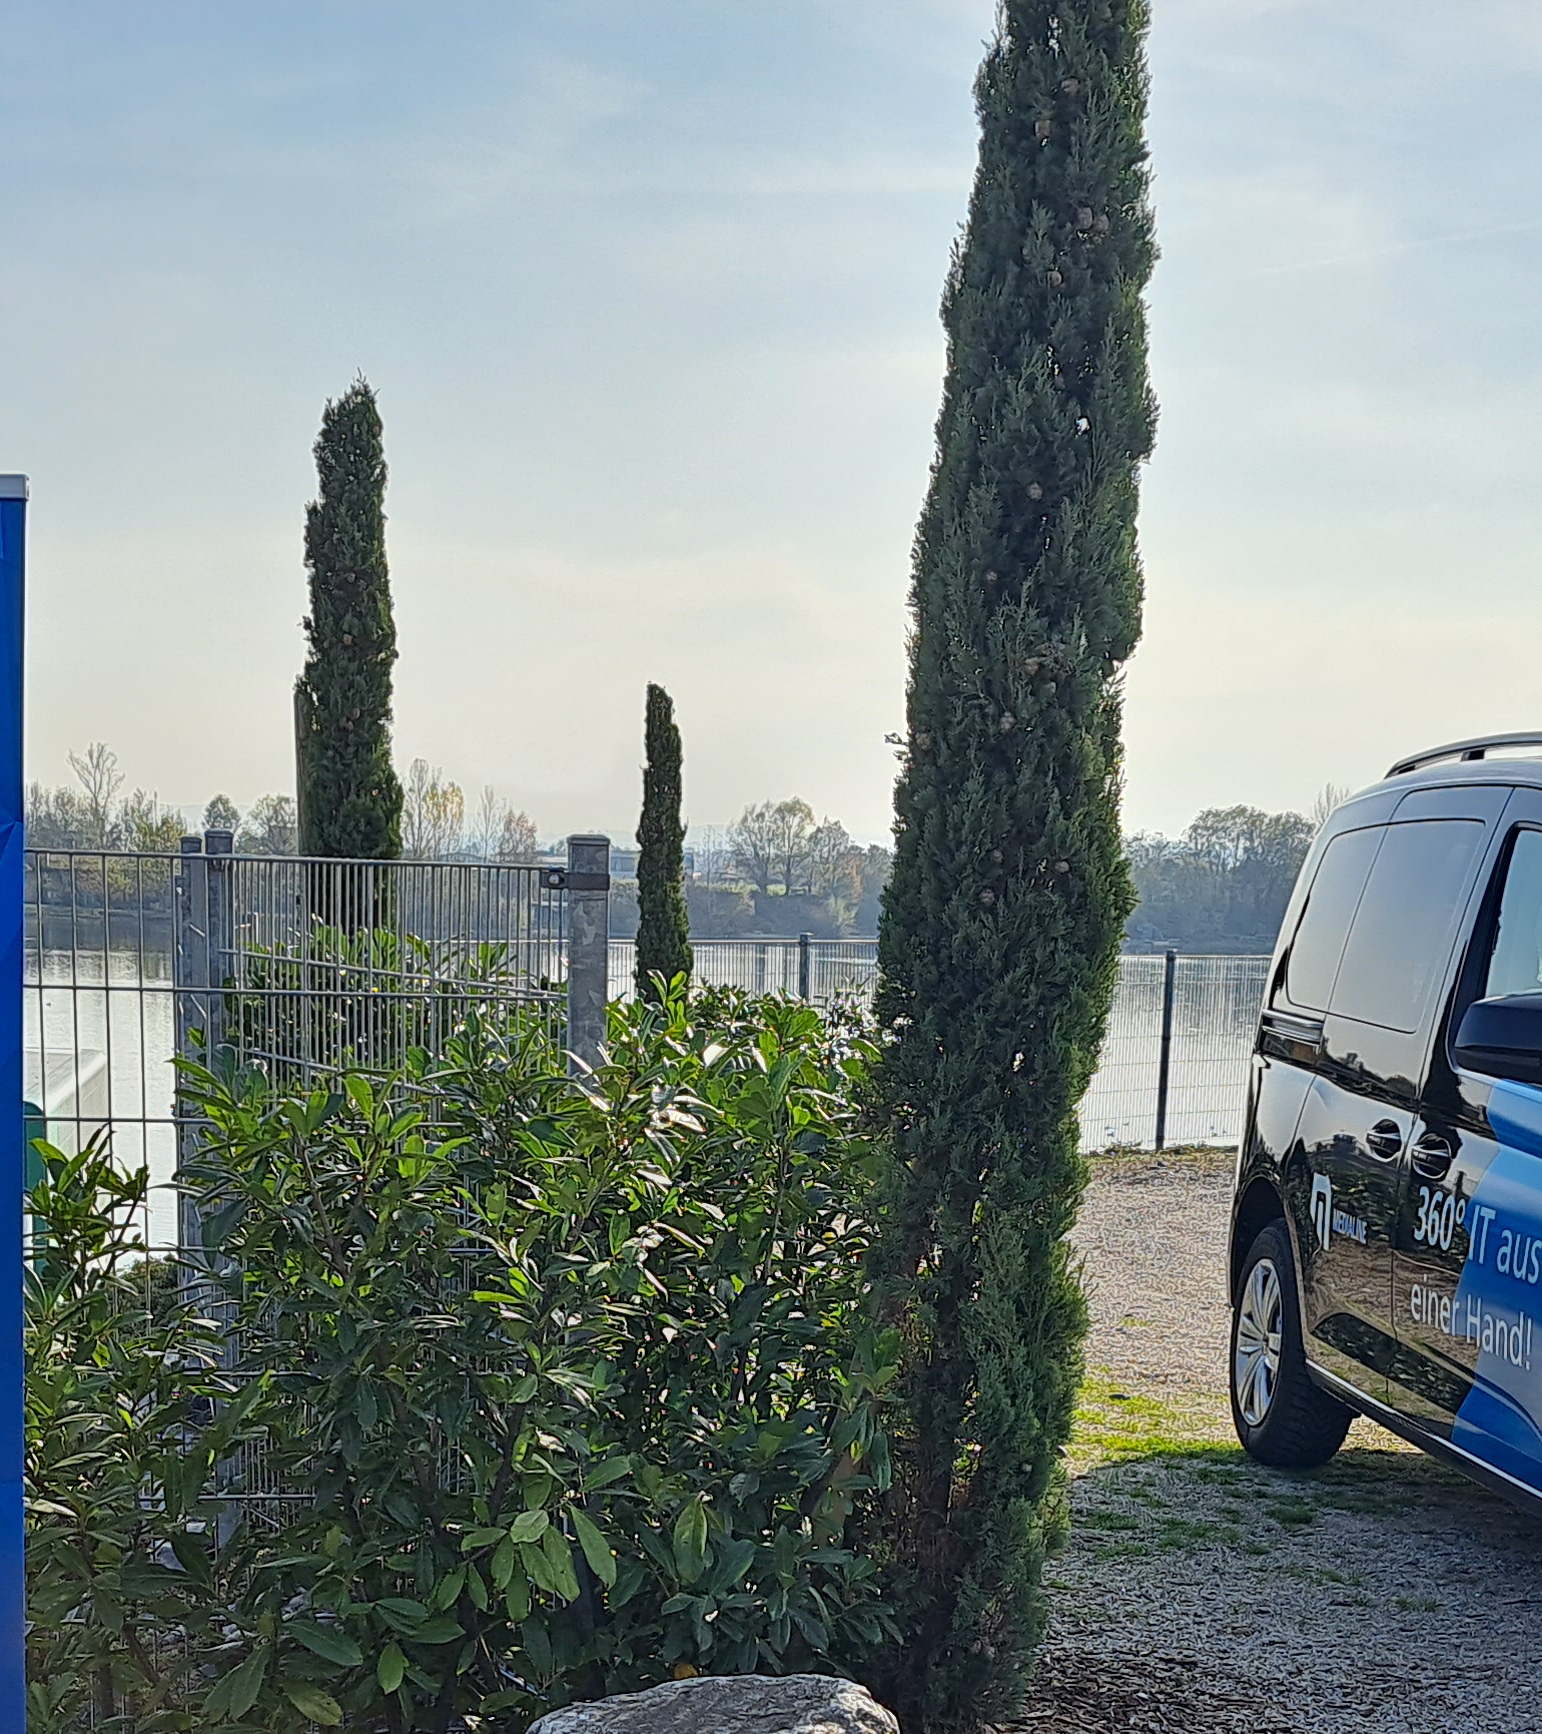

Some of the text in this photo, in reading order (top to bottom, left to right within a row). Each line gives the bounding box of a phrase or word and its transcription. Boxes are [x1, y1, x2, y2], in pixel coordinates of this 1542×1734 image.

[1332, 1208, 1368, 1245] MEDIALINE
[1468, 1204, 1496, 1265] IT
[1496, 1229, 1542, 1285] aus
[1410, 1273, 1534, 1372] einer Hand!
